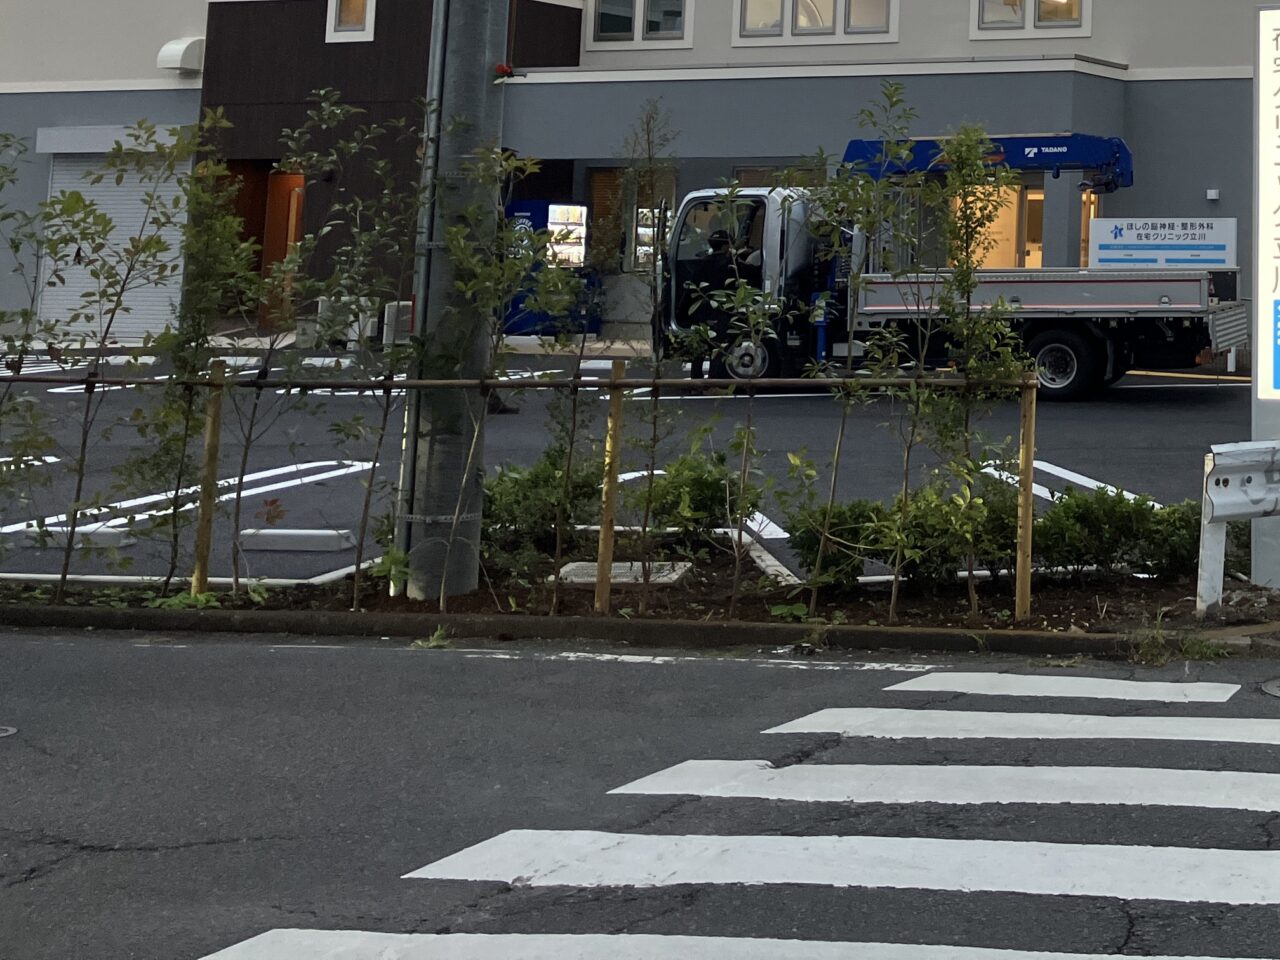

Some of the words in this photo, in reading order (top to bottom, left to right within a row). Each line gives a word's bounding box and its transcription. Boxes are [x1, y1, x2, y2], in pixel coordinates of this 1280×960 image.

[1136, 232, 1206, 241] 在宅クリニック立川
